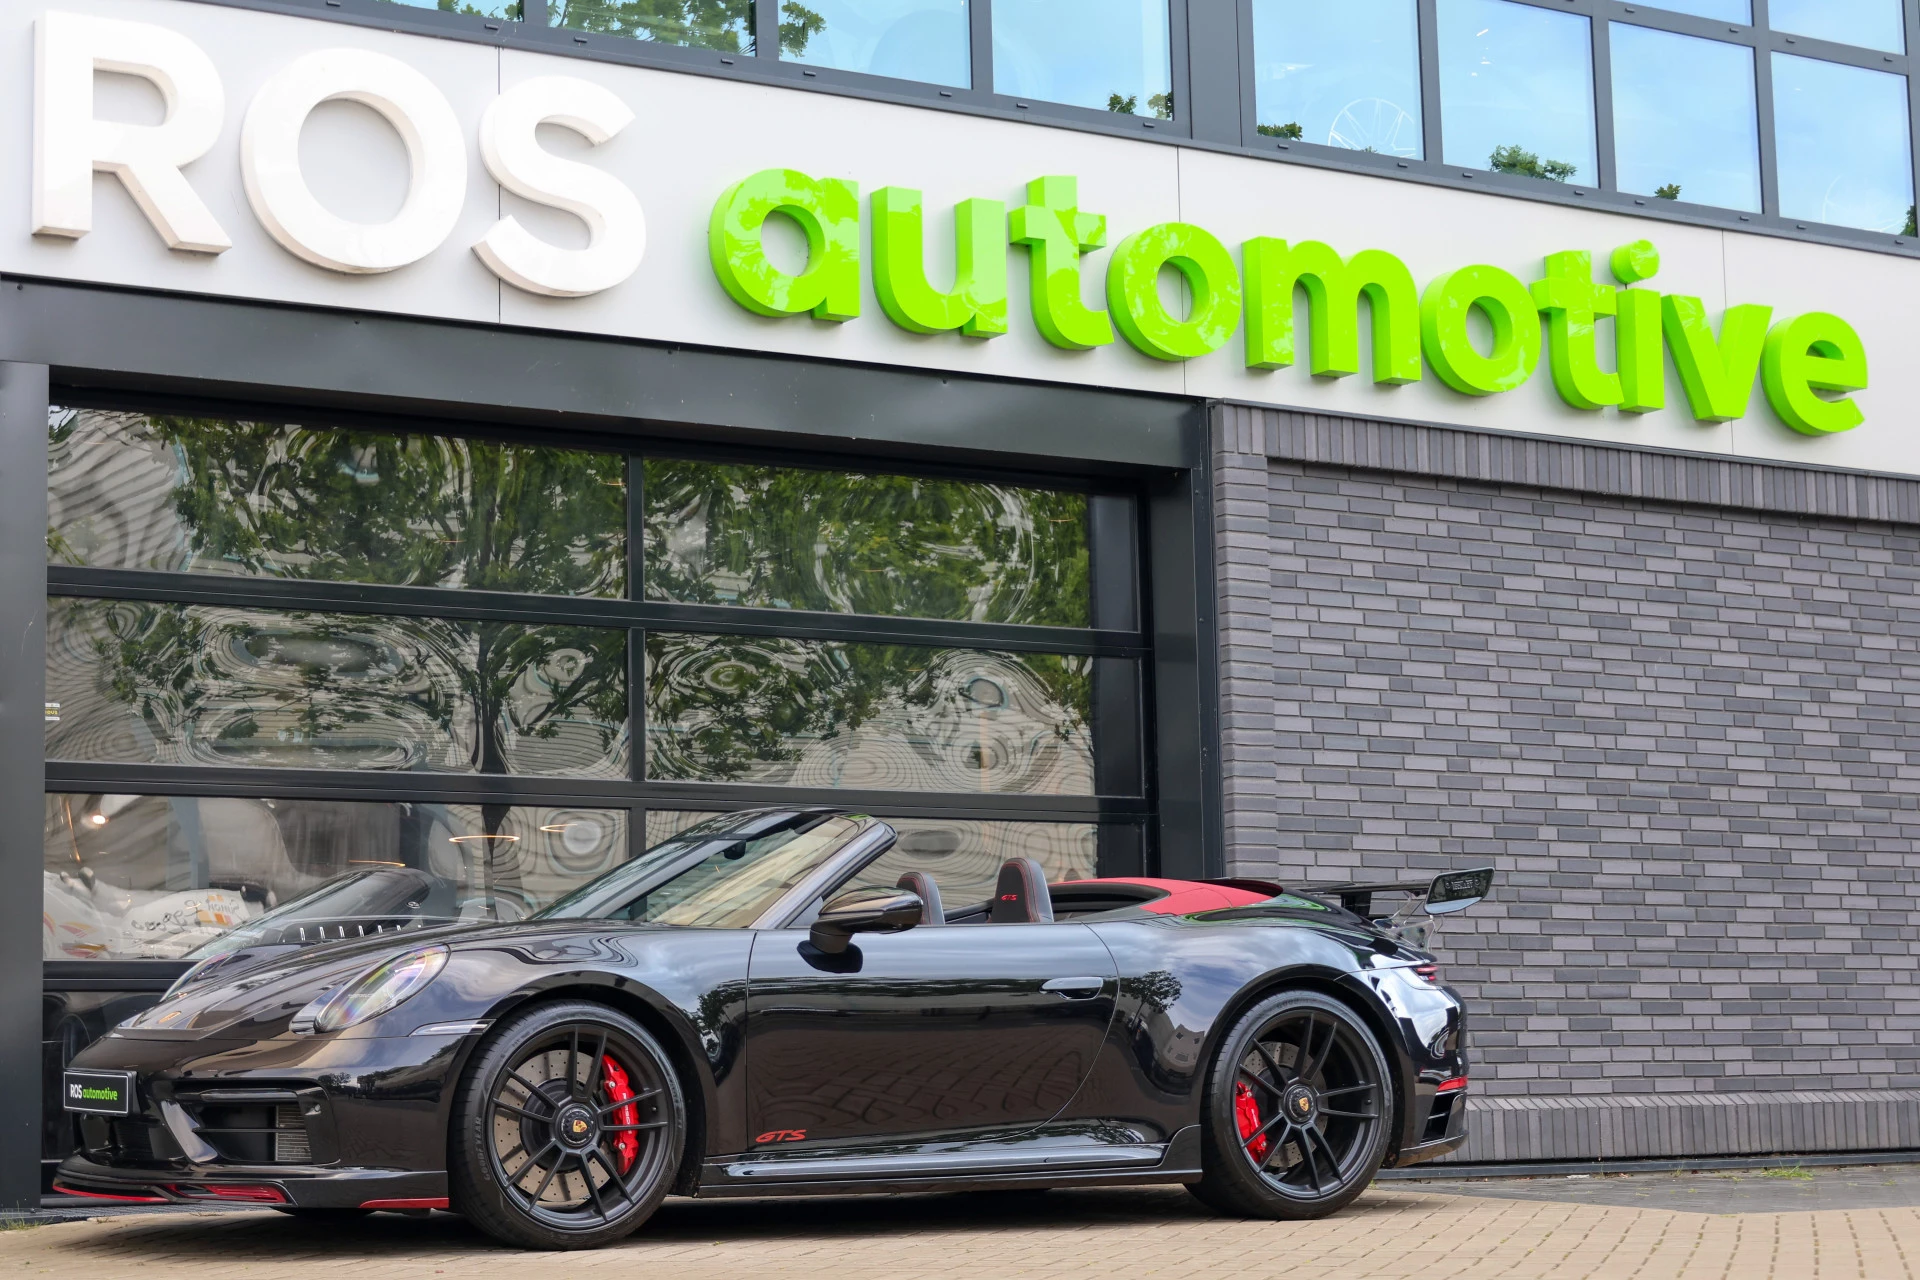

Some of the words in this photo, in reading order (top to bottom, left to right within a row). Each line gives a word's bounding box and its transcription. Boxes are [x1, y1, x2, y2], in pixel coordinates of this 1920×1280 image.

[31, 11, 647, 298] ROS
[709, 167, 1869, 437] automotive
[70, 1083, 83, 1099] ROS
[82, 1087, 118, 1101] automotive
[755, 1129, 807, 1143] GTS
